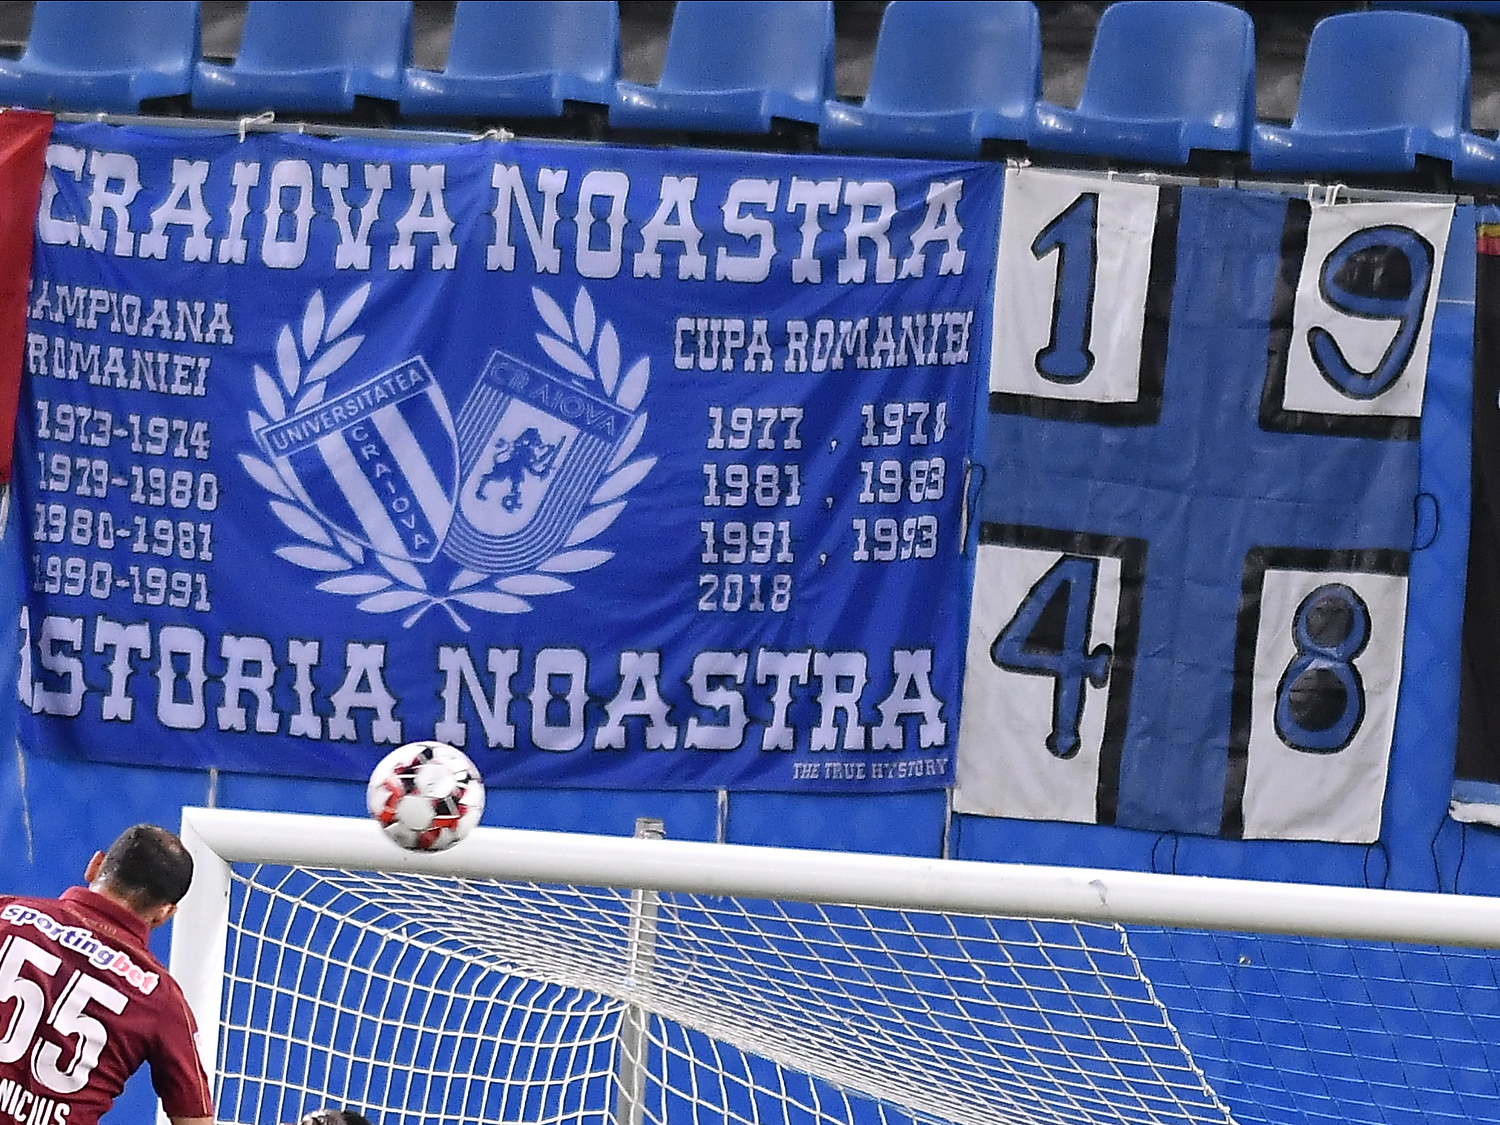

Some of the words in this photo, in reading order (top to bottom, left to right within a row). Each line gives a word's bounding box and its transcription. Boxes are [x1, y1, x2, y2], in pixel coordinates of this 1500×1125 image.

[38, 143, 458, 271] CRAIOVA
[485, 163, 967, 284] NOASTRA
[27, 279, 234, 345] AMPIOANA
[27, 332, 211, 397] ROMANIEI
[674, 317, 772, 373] CUPA
[37, 400, 210, 460] 1973-1974
[274, 369, 423, 451] UNIVERSITATEA
[707, 406, 804, 450] 1977
[37, 452, 218, 511] 1979-1980
[352, 426, 430, 550] CRAIOVA
[703, 464, 801, 507] 1981
[34, 503, 213, 562] 1980-1981
[700, 521, 794, 564] 1991
[699, 574, 791, 613] 2018
[434, 645, 947, 752] NOASTRA
[793, 762, 820, 779] THE
[825, 761, 866, 780] TRUE
[1, 904, 159, 994] sportingbet
